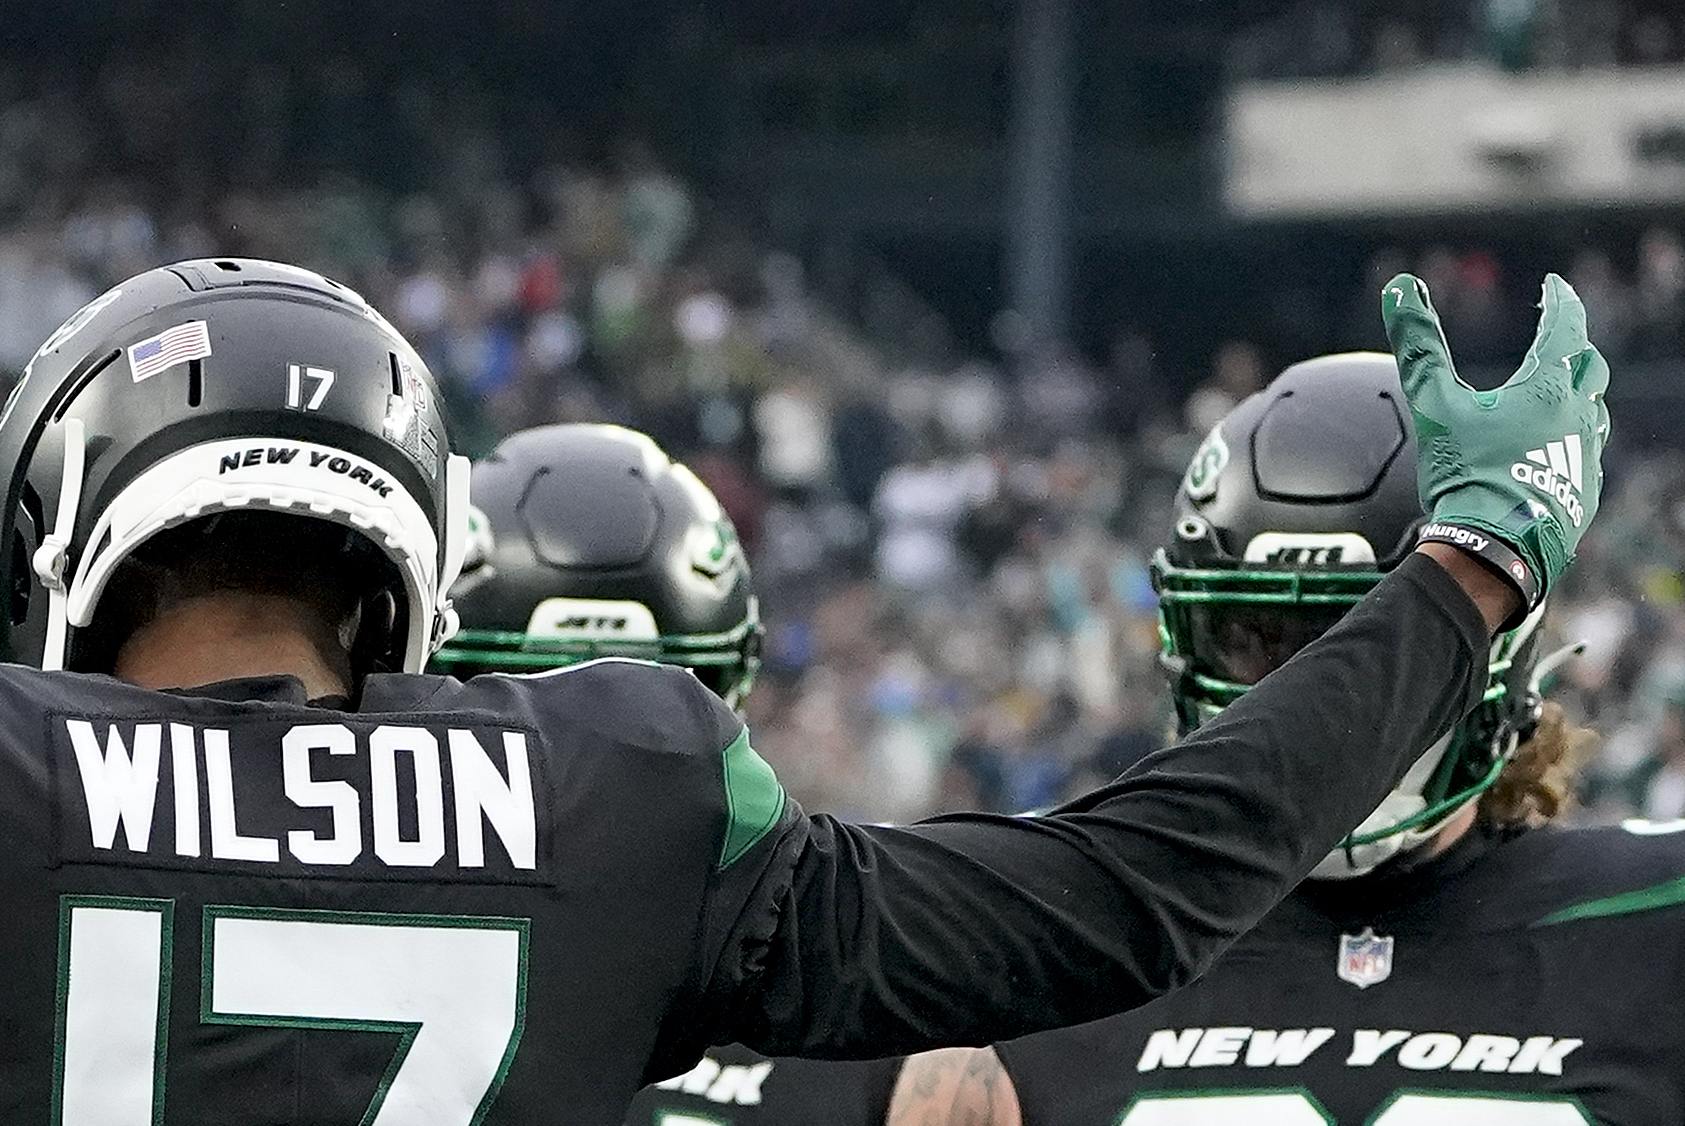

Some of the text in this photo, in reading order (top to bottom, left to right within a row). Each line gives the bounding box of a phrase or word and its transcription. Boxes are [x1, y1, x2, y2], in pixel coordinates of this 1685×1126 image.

[288, 364, 335, 410] 17
[219, 448, 394, 499] NEW YORK
[1511, 463, 1583, 528] adidas
[1422, 523, 1489, 552] Hungry
[66, 719, 536, 869] WILSON
[1137, 1027, 1583, 1075] NEW YORK
